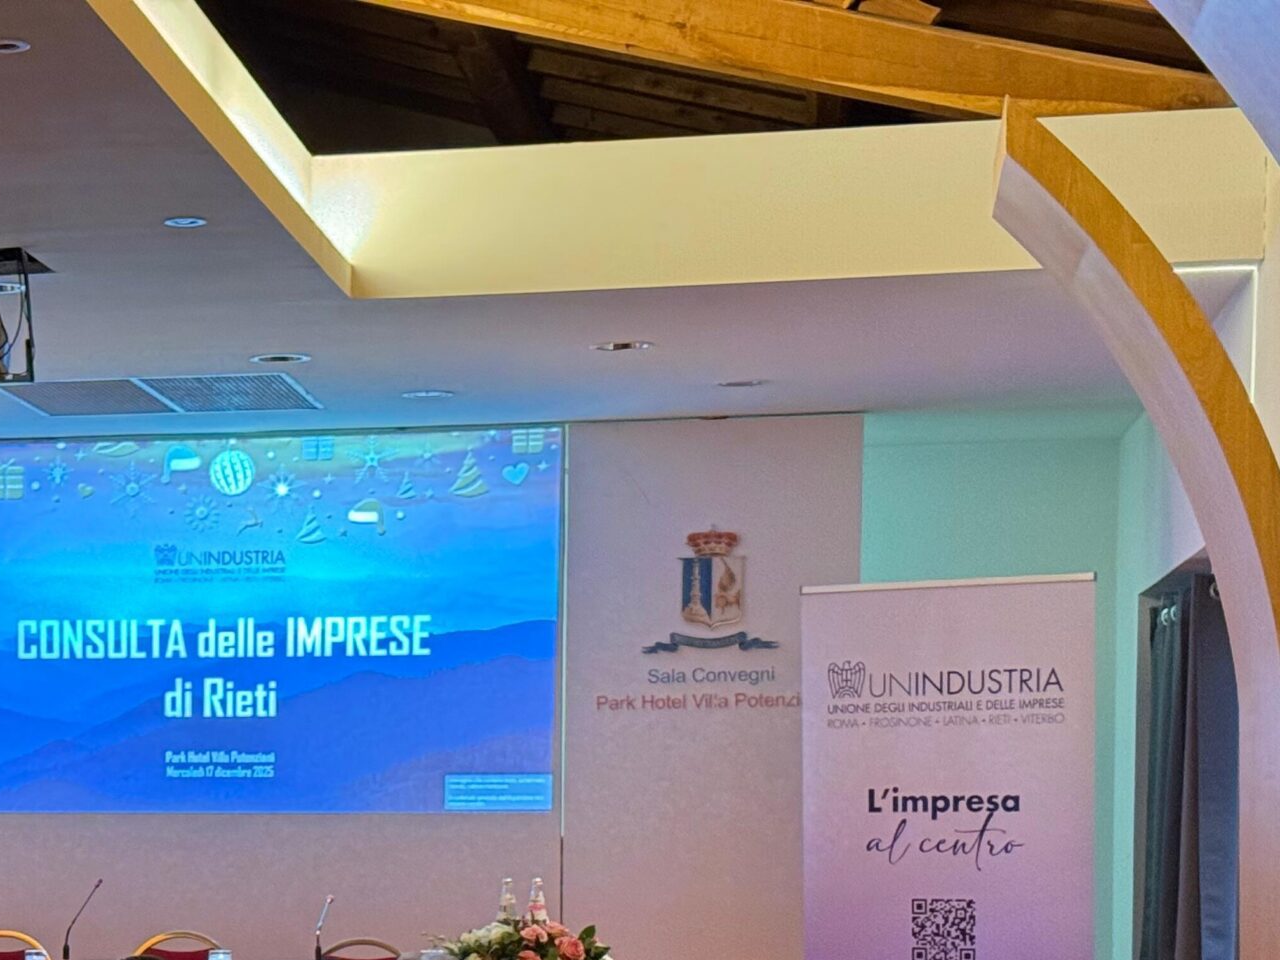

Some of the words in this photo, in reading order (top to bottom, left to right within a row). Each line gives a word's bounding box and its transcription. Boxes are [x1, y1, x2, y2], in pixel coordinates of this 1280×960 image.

[177, 550, 286, 566] UNINDUSTRIA
[17, 619, 187, 659] CONSULTA
[197, 618, 275, 658] delle
[286, 615, 432, 657] IMPRESE
[647, 668, 686, 684] Sala
[692, 666, 775, 685] Convegni
[869, 667, 1064, 698] UNINDUSTRIA
[164, 678, 192, 718] di
[202, 677, 278, 718] Rieti
[596, 695, 635, 710] Park
[641, 694, 686, 710] Hotel
[734, 692, 801, 708] Potenzi
[827, 703, 870, 714] UNIONE
[874, 702, 905, 713] DEGLI
[908, 700, 973, 712] INDUSTRIALI
[976, 700, 983, 711] E
[986, 699, 1015, 710] DELLE
[1019, 697, 1065, 709] IMPRESE
[867, 786, 1020, 820] L'impresa
[866, 818, 911, 865] al
[918, 811, 1025, 871] centro
